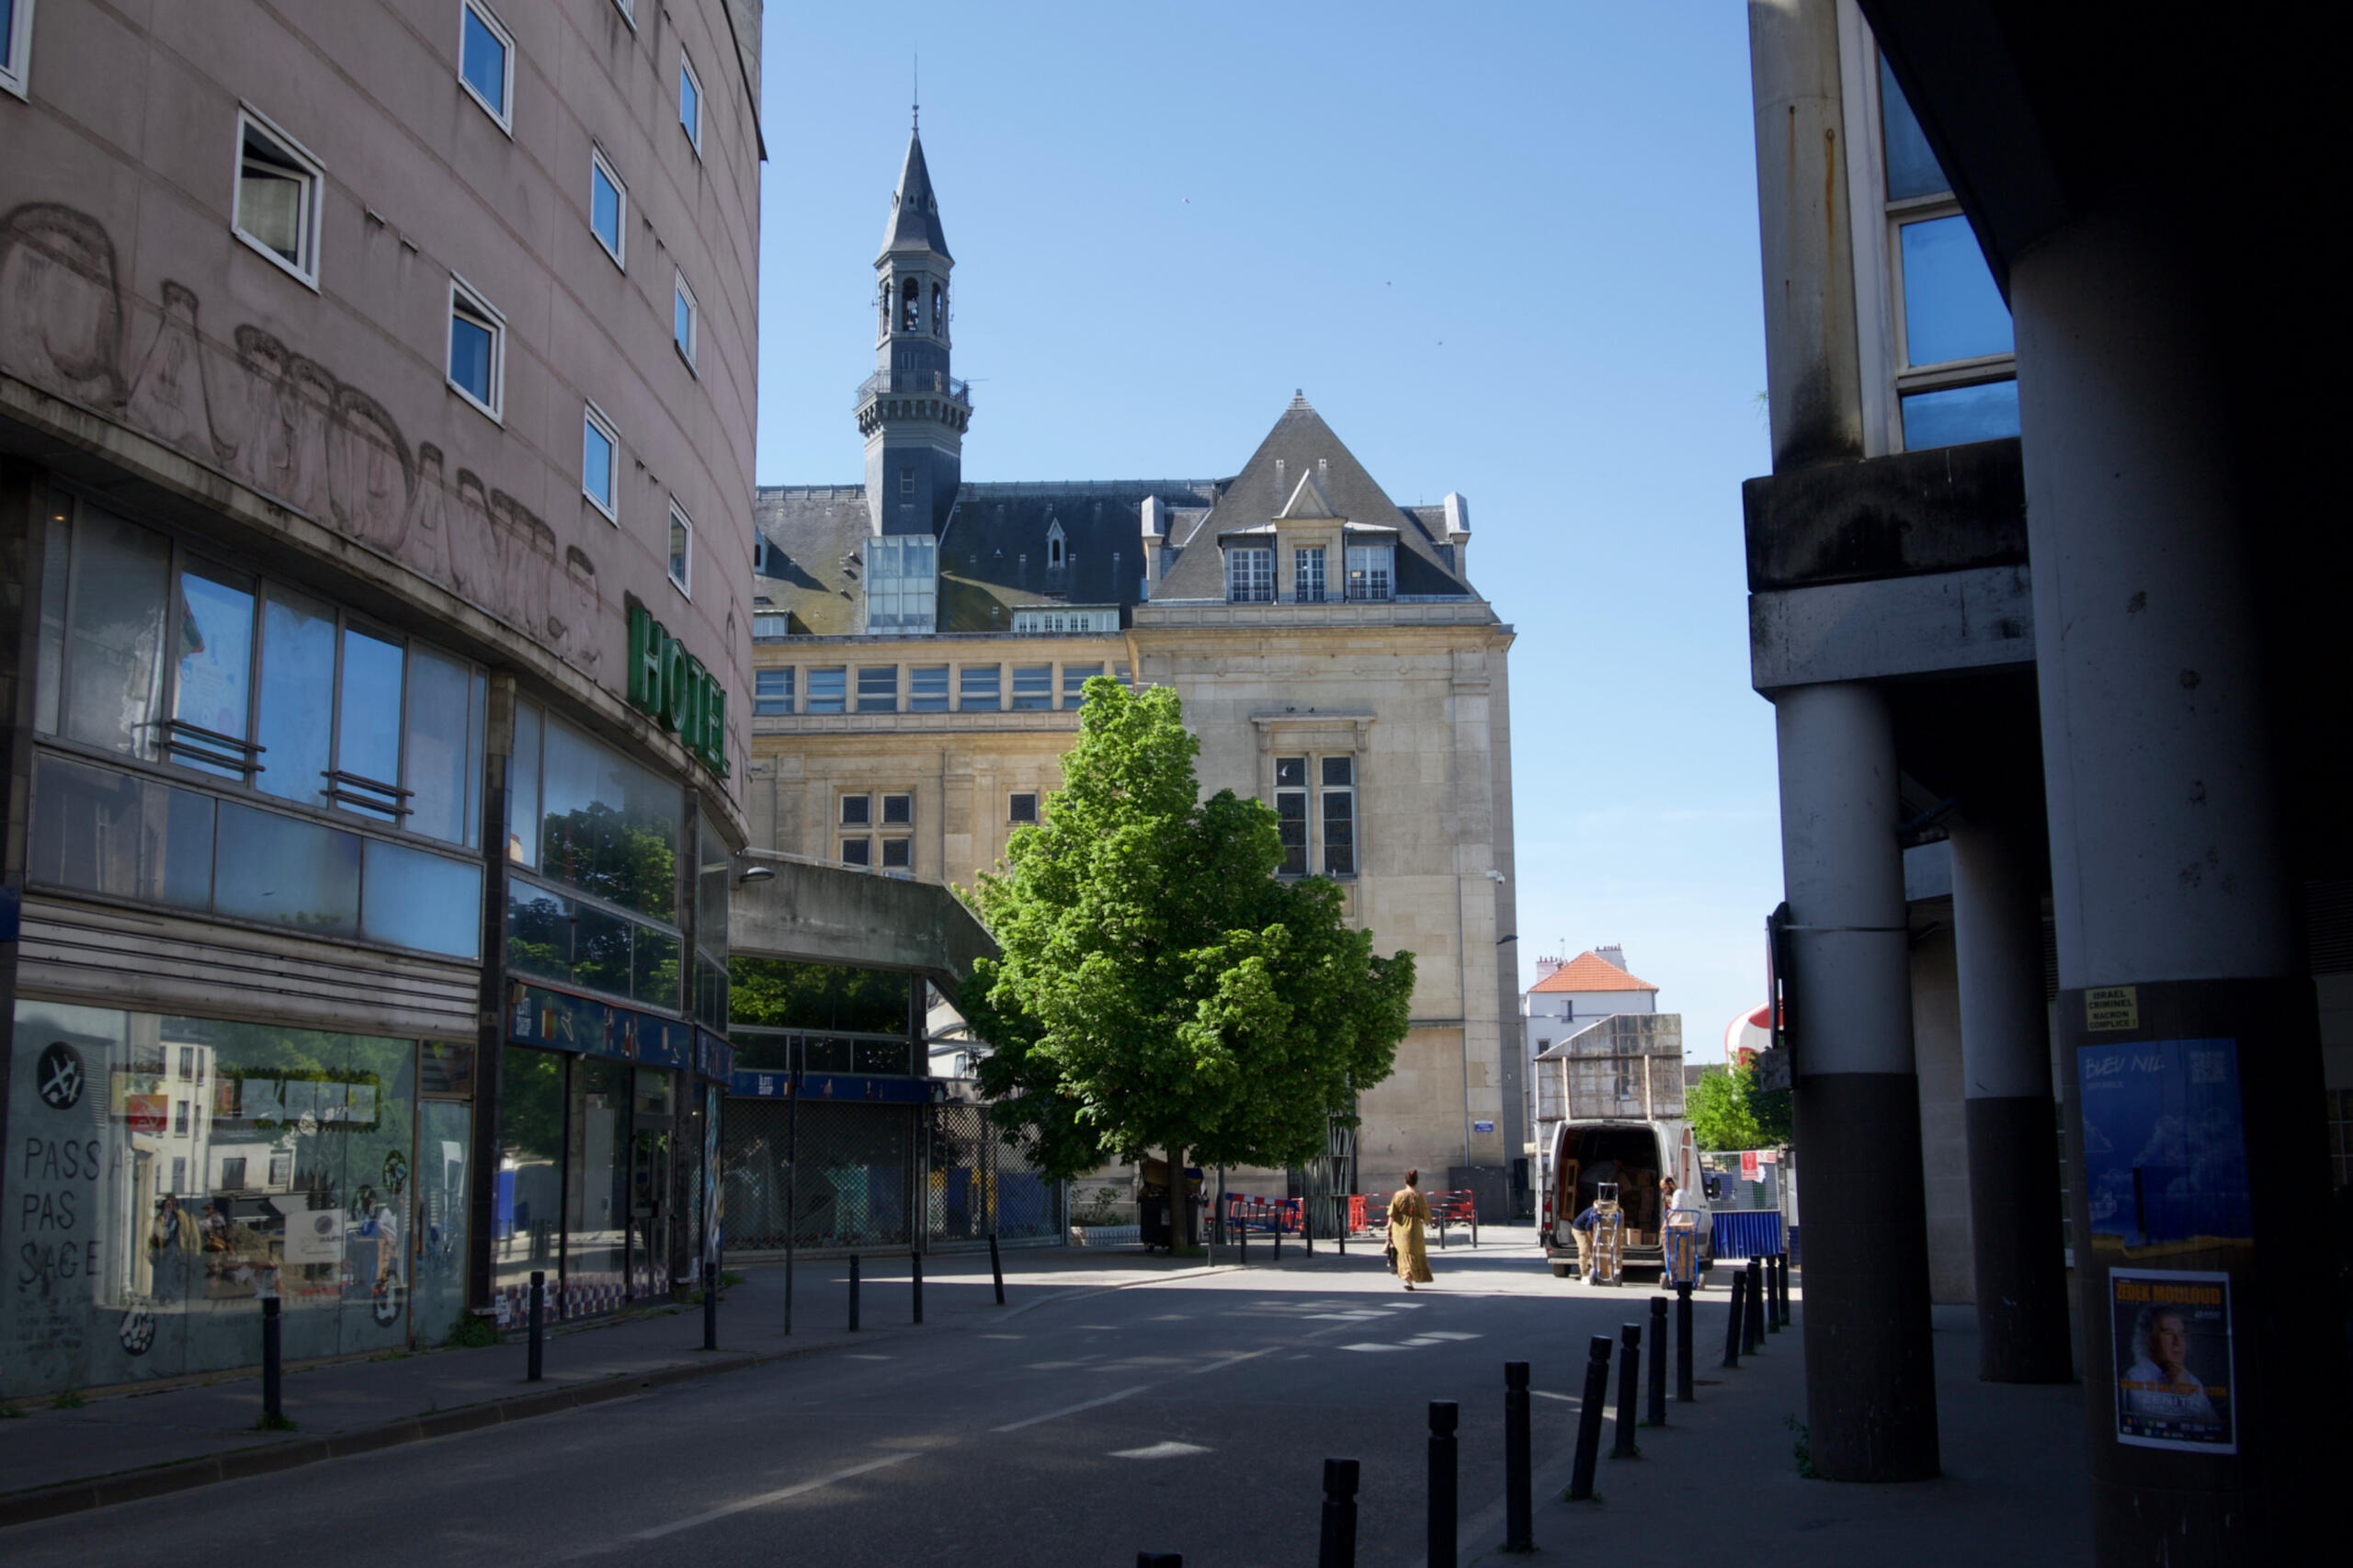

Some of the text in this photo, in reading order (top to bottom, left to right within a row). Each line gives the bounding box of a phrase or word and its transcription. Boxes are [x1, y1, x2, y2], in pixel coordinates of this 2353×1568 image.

[631, 606, 731, 778] HOTEL
[2093, 989, 2126, 999] ISRAEL
[2088, 998, 2133, 1010] CRIMINEL
[2093, 1010, 2130, 1020] MACRON
[2090, 1018, 2130, 1030] COMPLICE
[22, 1190, 75, 1233] PAS
[18, 1239, 104, 1287] SAGE
